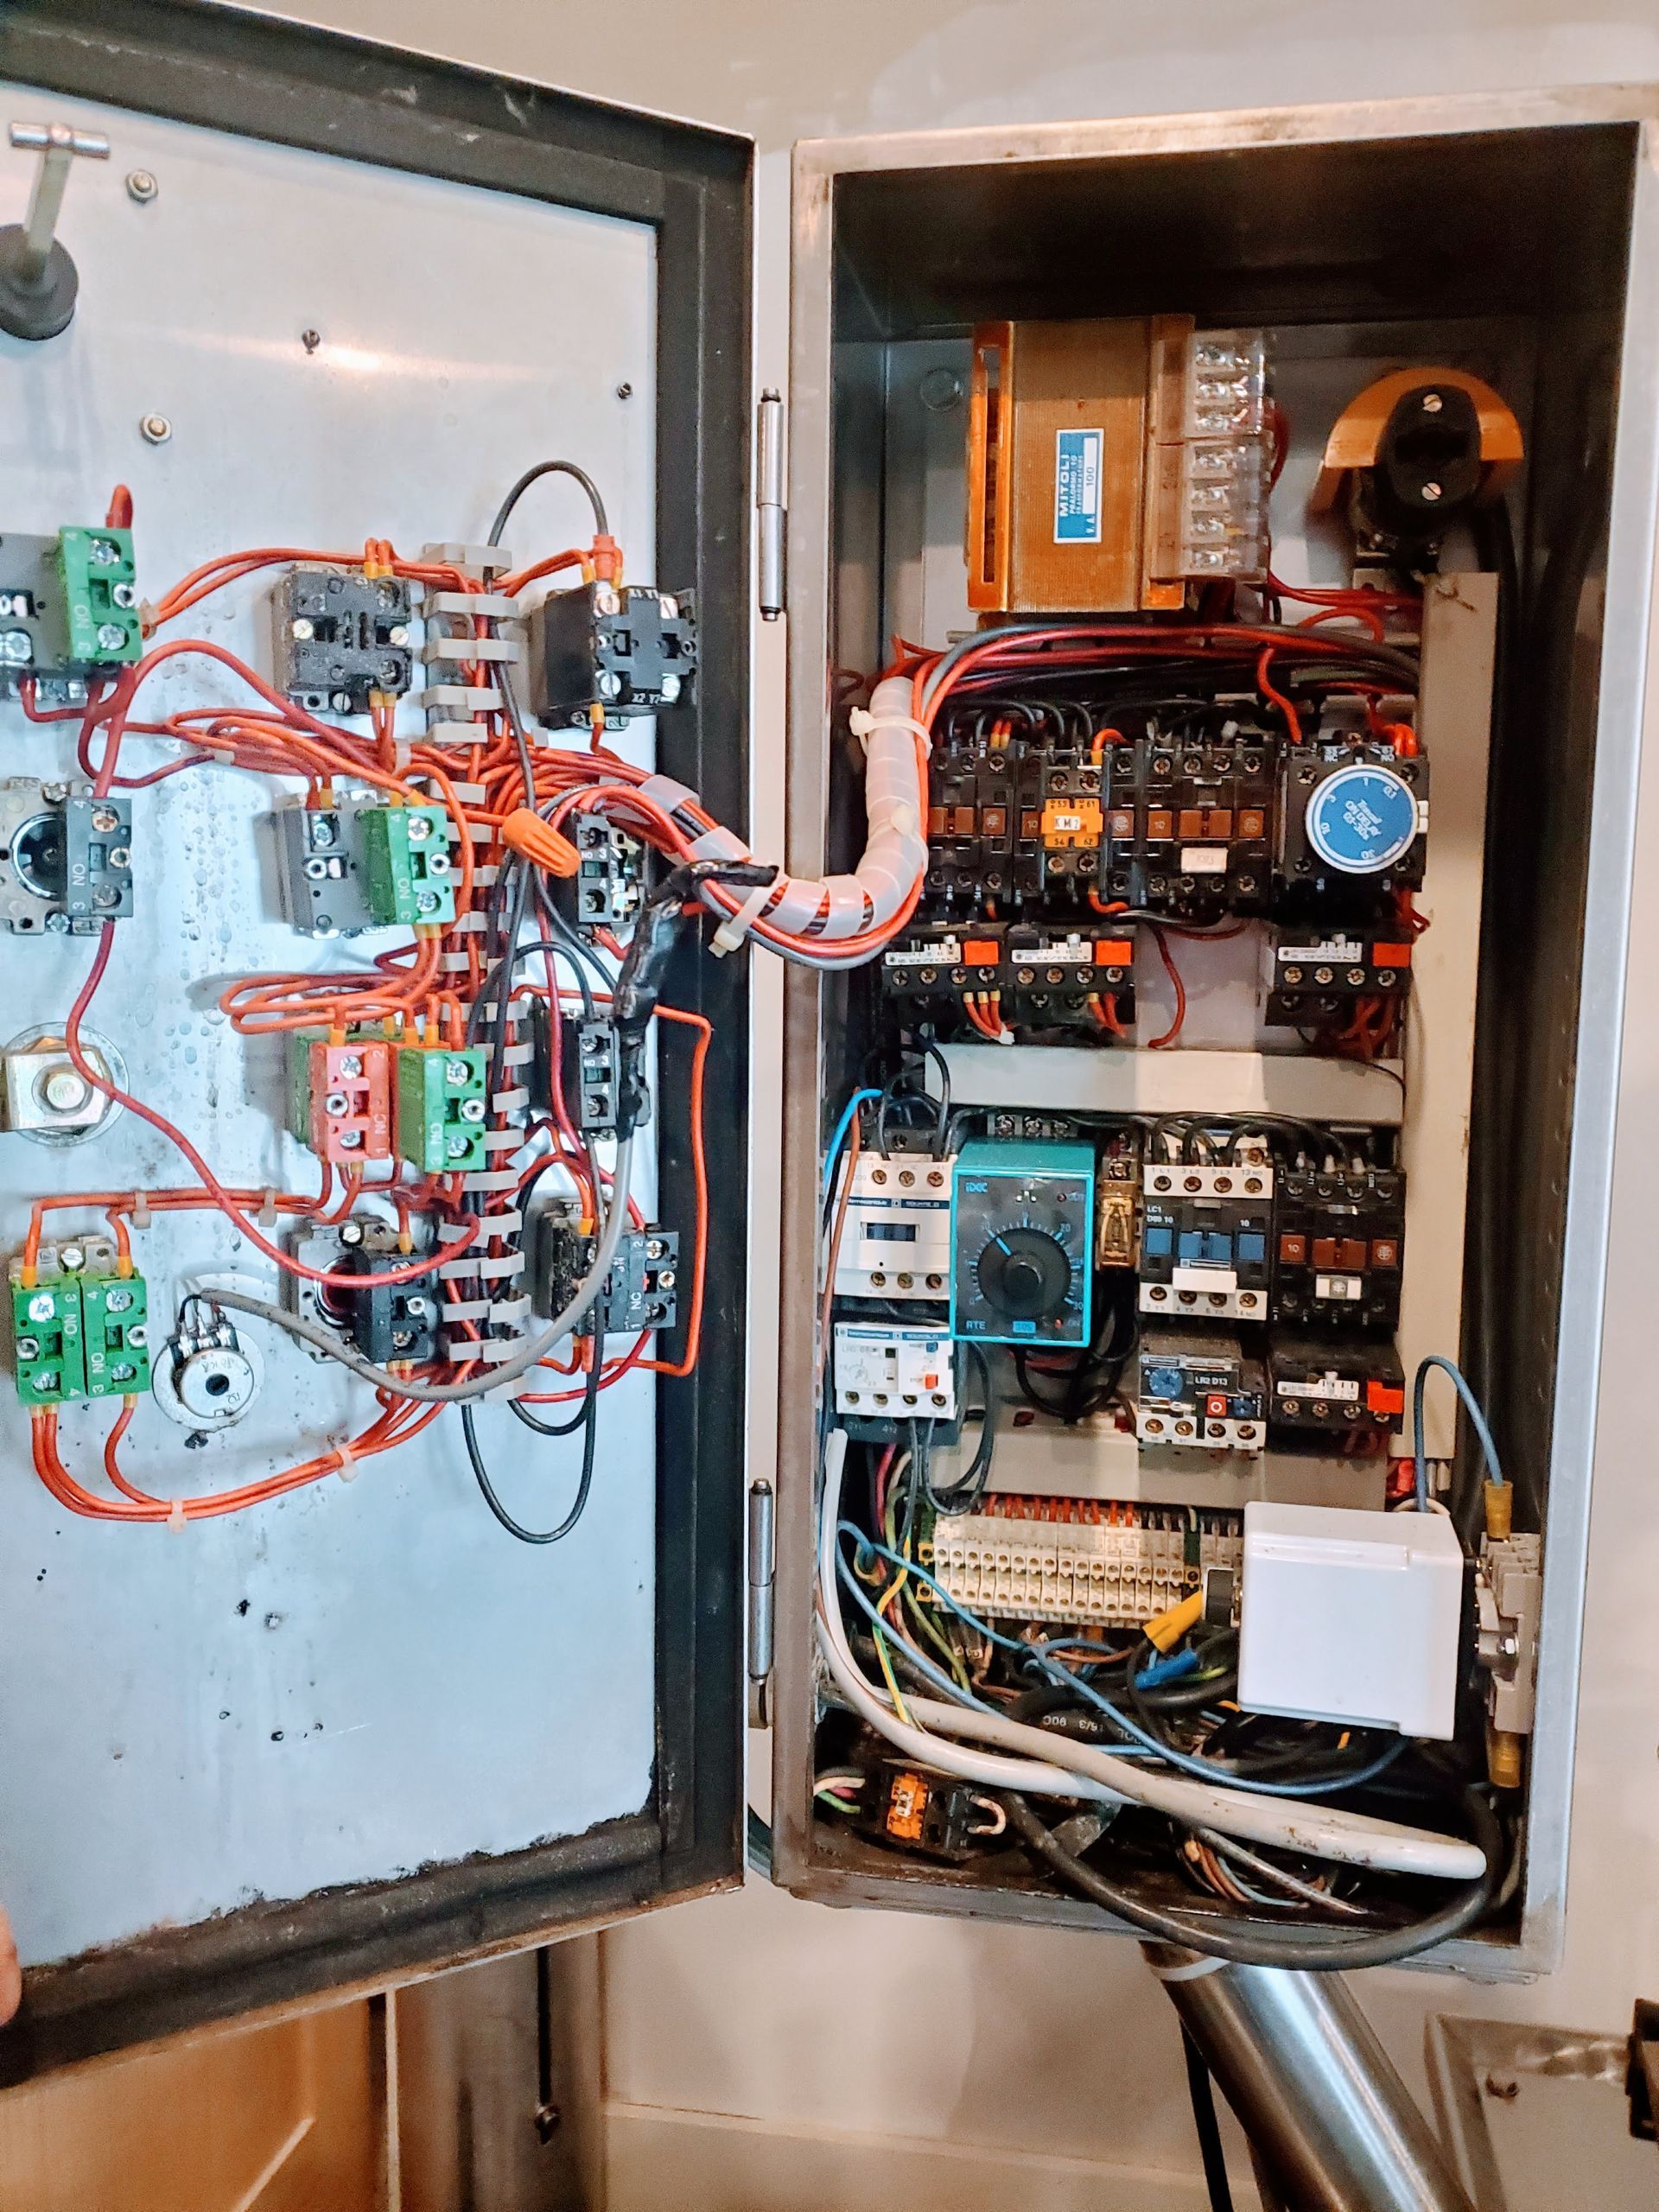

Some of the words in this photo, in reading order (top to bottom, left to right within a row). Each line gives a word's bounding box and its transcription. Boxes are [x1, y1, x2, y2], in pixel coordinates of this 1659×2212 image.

[1059, 454, 1070, 517] MITOLI
[73, 800, 85, 809] 4
[599, 849, 607, 859] 3
[73, 863, 86, 887] NO
[397, 878, 410, 899] NO
[72, 901, 86, 910] 3
[372, 1049, 385, 1058] 2
[601, 1055, 609, 1065] 3
[374, 1113, 386, 1135] NC
[430, 1123, 442, 1146] NO
[1288, 1244, 1300, 1253] 10
[65, 1294, 76, 1302] 3
[87, 1291, 98, 1300] 4
[631, 1292, 642, 1310] NC
[64, 1313, 78, 1335] NO
[91, 1352, 105, 1373] NO
[1195, 1376, 1211, 1384] LR2
[1211, 1377, 1228, 1386] D13
[92, 1384, 105, 1394] 3
[1042, 1715, 1067, 1726] 90C
